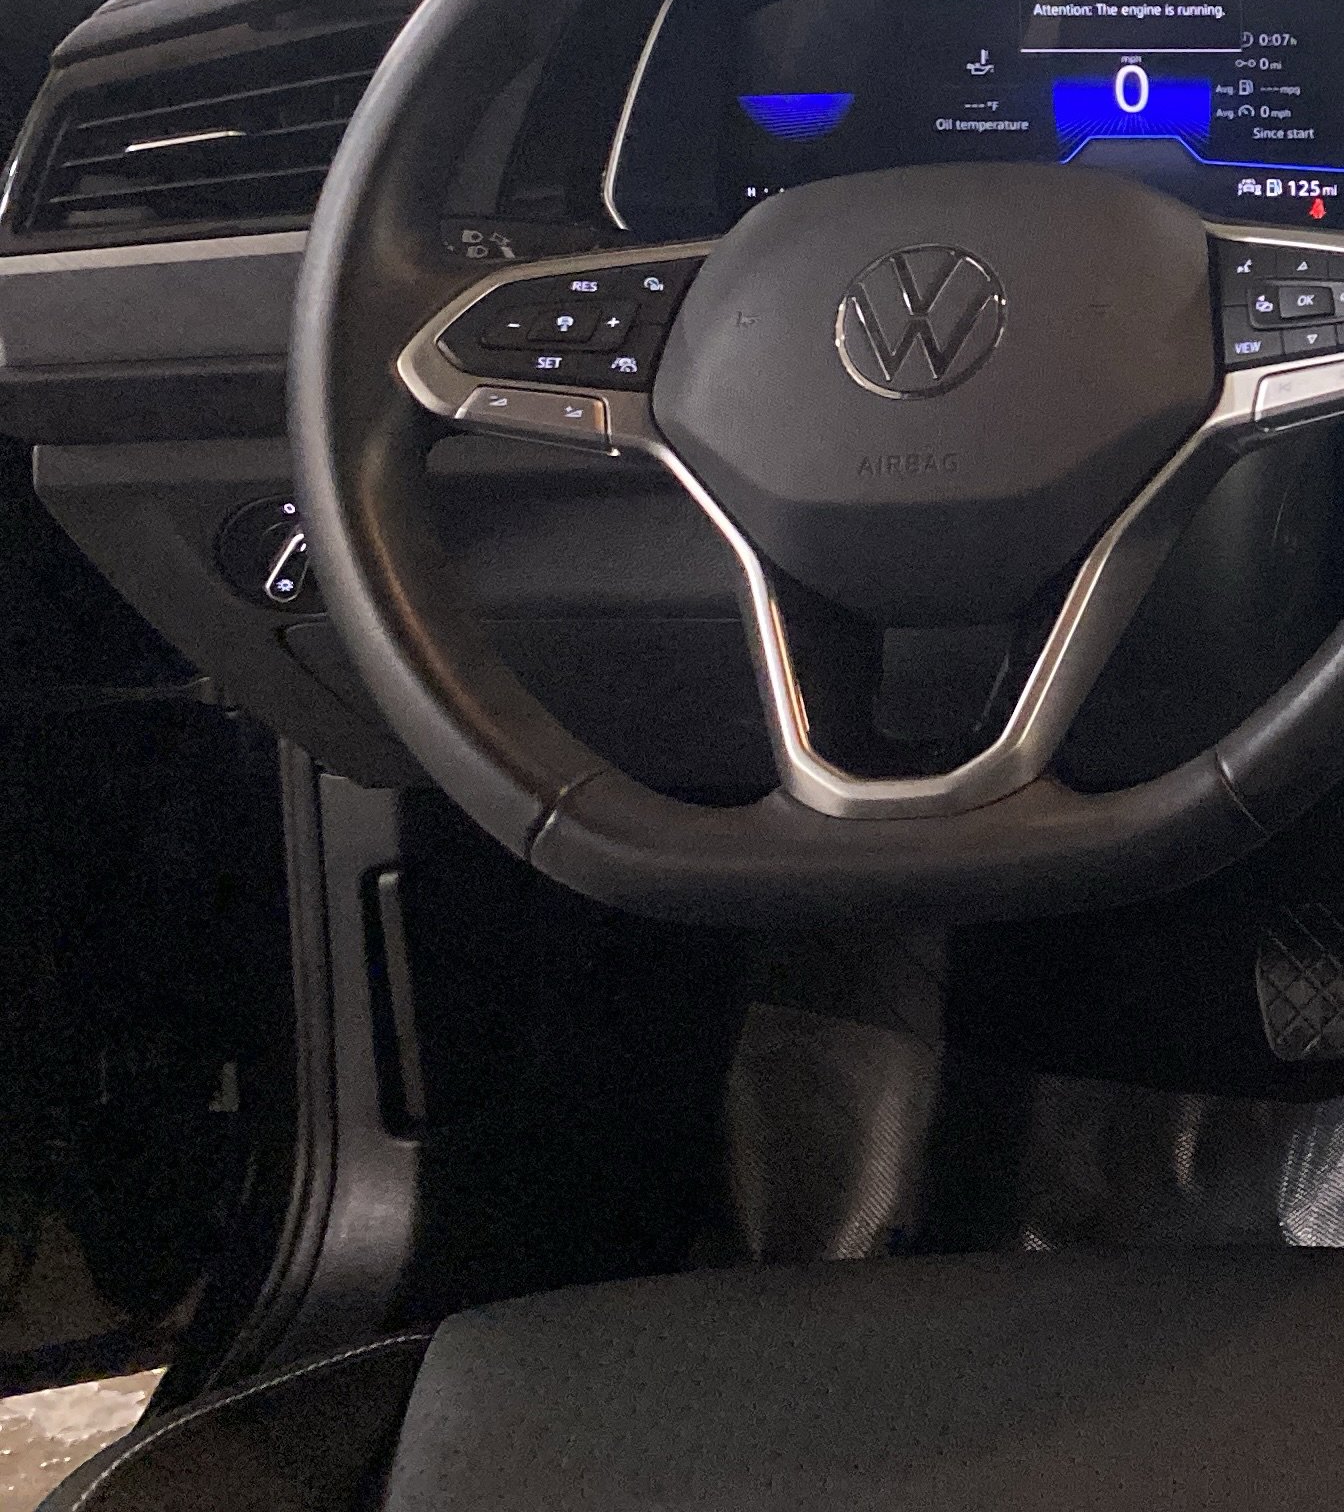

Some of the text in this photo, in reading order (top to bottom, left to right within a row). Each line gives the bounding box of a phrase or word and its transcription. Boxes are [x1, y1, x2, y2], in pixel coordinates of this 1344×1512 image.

[1033, 3, 1226, 19] Attention: The engine is running.
[1115, 65, 1149, 113] 0
[935, 118, 1029, 133] Oil temperature
[1253, 127, 1315, 139] Since start
[571, 280, 598, 293] RES
[1297, 294, 1315, 307] OK
[1235, 340, 1262, 354] VIEW
[536, 356, 562, 369] SET
[857, 452, 960, 477] AIRBAG
